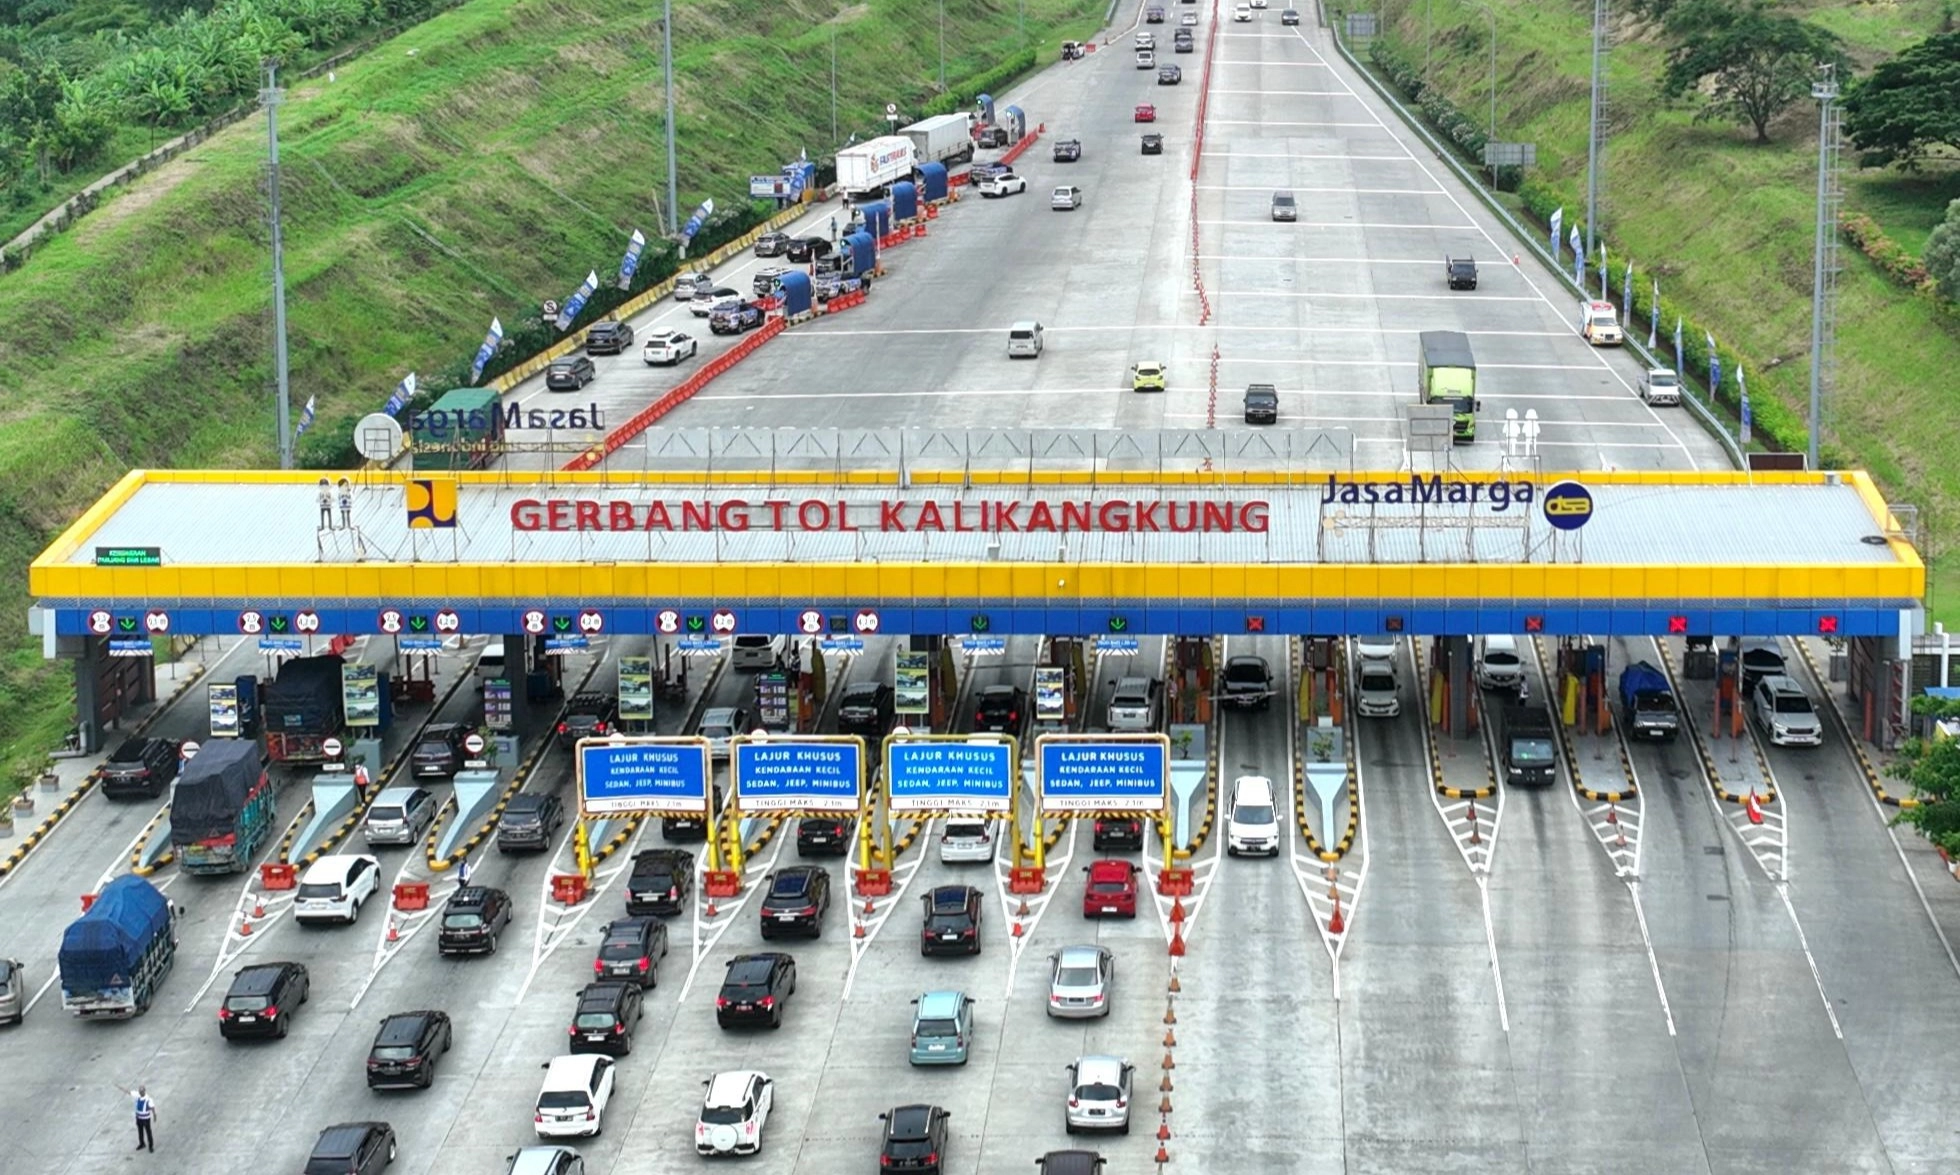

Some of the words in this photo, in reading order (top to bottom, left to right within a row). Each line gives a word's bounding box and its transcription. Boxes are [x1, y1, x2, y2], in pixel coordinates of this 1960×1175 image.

[1320, 474, 1535, 512] JasaMarga
[510, 499, 750, 532] GERBANG
[763, 499, 859, 532] TOL
[880, 500, 1270, 533] KALIKANGKUNG
[609, 752, 639, 763] LAJUR
[642, 752, 679, 763] KHUSUS
[754, 751, 791, 761] LAJUR
[796, 751, 842, 762] KHUSUS
[903, 751, 943, 762] LAJUR
[947, 751, 996, 762] KHUSUS
[1061, 751, 1097, 762] LAJUR
[1099, 751, 1145, 762] KHUSUS
[610, 766, 655, 775] KENDARAAN
[659, 766, 679, 775] KECIL
[755, 765, 812, 775] KENDARAAN
[815, 765, 841, 775] KECIL
[905, 766, 964, 775] KENDARAAN
[967, 766, 993, 775] KECIL
[1059, 765, 1116, 774] KENDARAAN
[1118, 765, 1144, 774] KECIL
[654, 779, 685, 788] MINIBUS
[811, 779, 851, 789] MINIBUS
[963, 779, 1003, 789] MINIBUS
[1116, 779, 1156, 788] MINIBUS
[755, 799, 787, 807] TINGGI
[789, 798, 814, 806] MAKS
[911, 799, 944, 807] TINGGI
[947, 798, 972, 806] MAKS
[1059, 799, 1091, 807] TINGGI
[1093, 798, 1118, 806] MAKS
